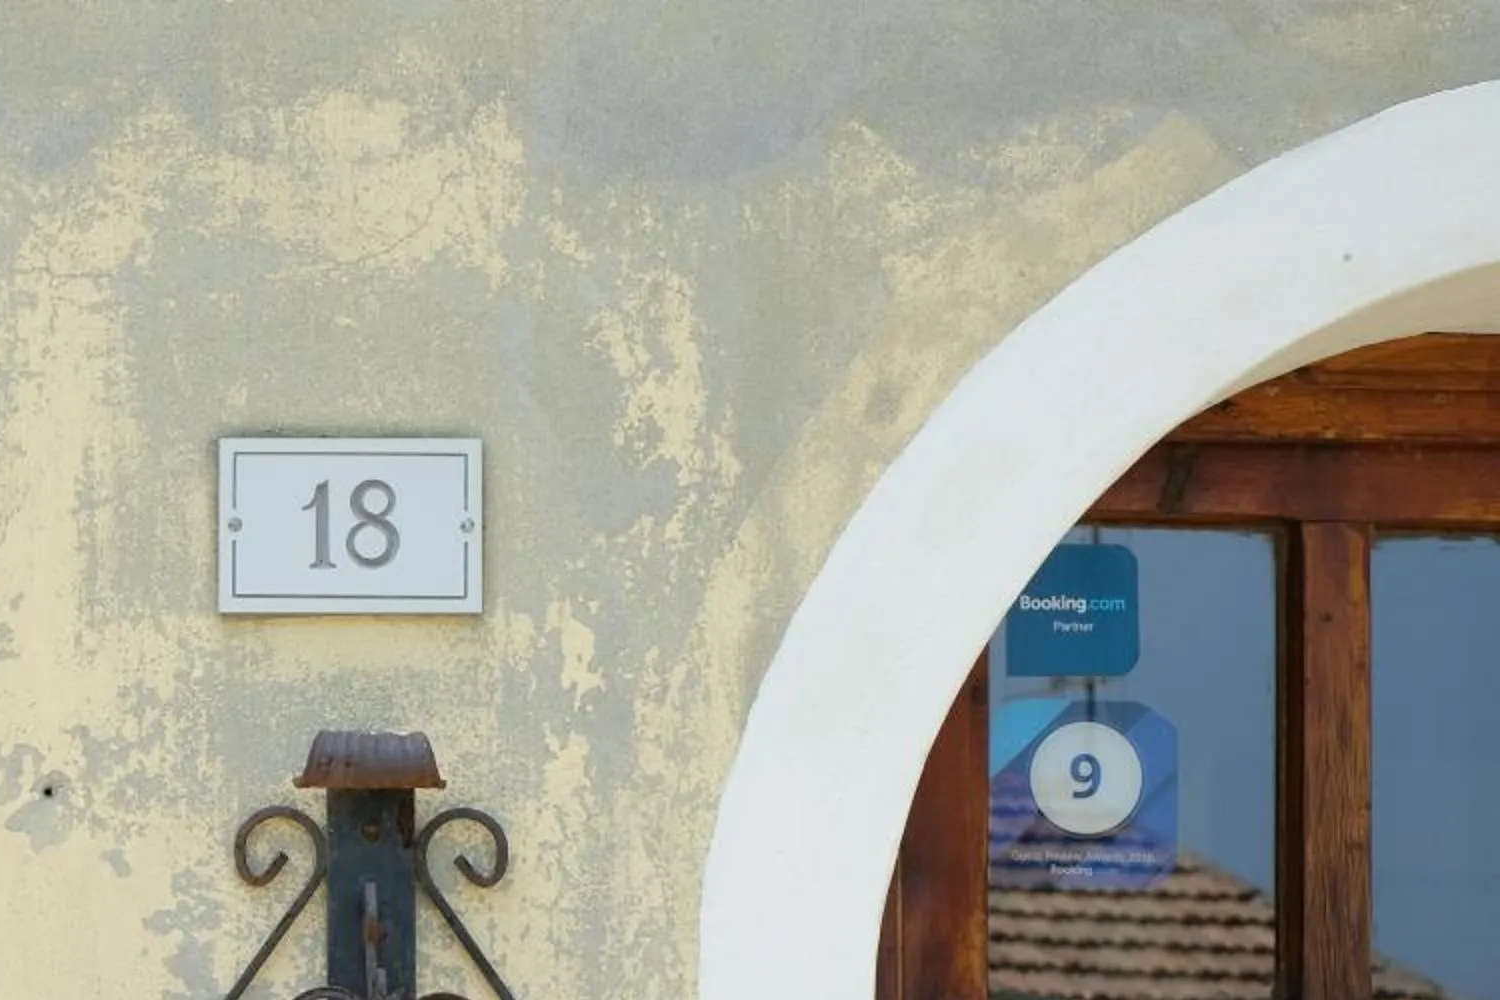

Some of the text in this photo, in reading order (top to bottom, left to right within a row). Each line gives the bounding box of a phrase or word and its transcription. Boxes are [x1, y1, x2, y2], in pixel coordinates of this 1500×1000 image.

[300, 478, 400, 570] 18
[1020, 594, 1126, 614] Booking.com
[1069, 753, 1101, 799] 9
